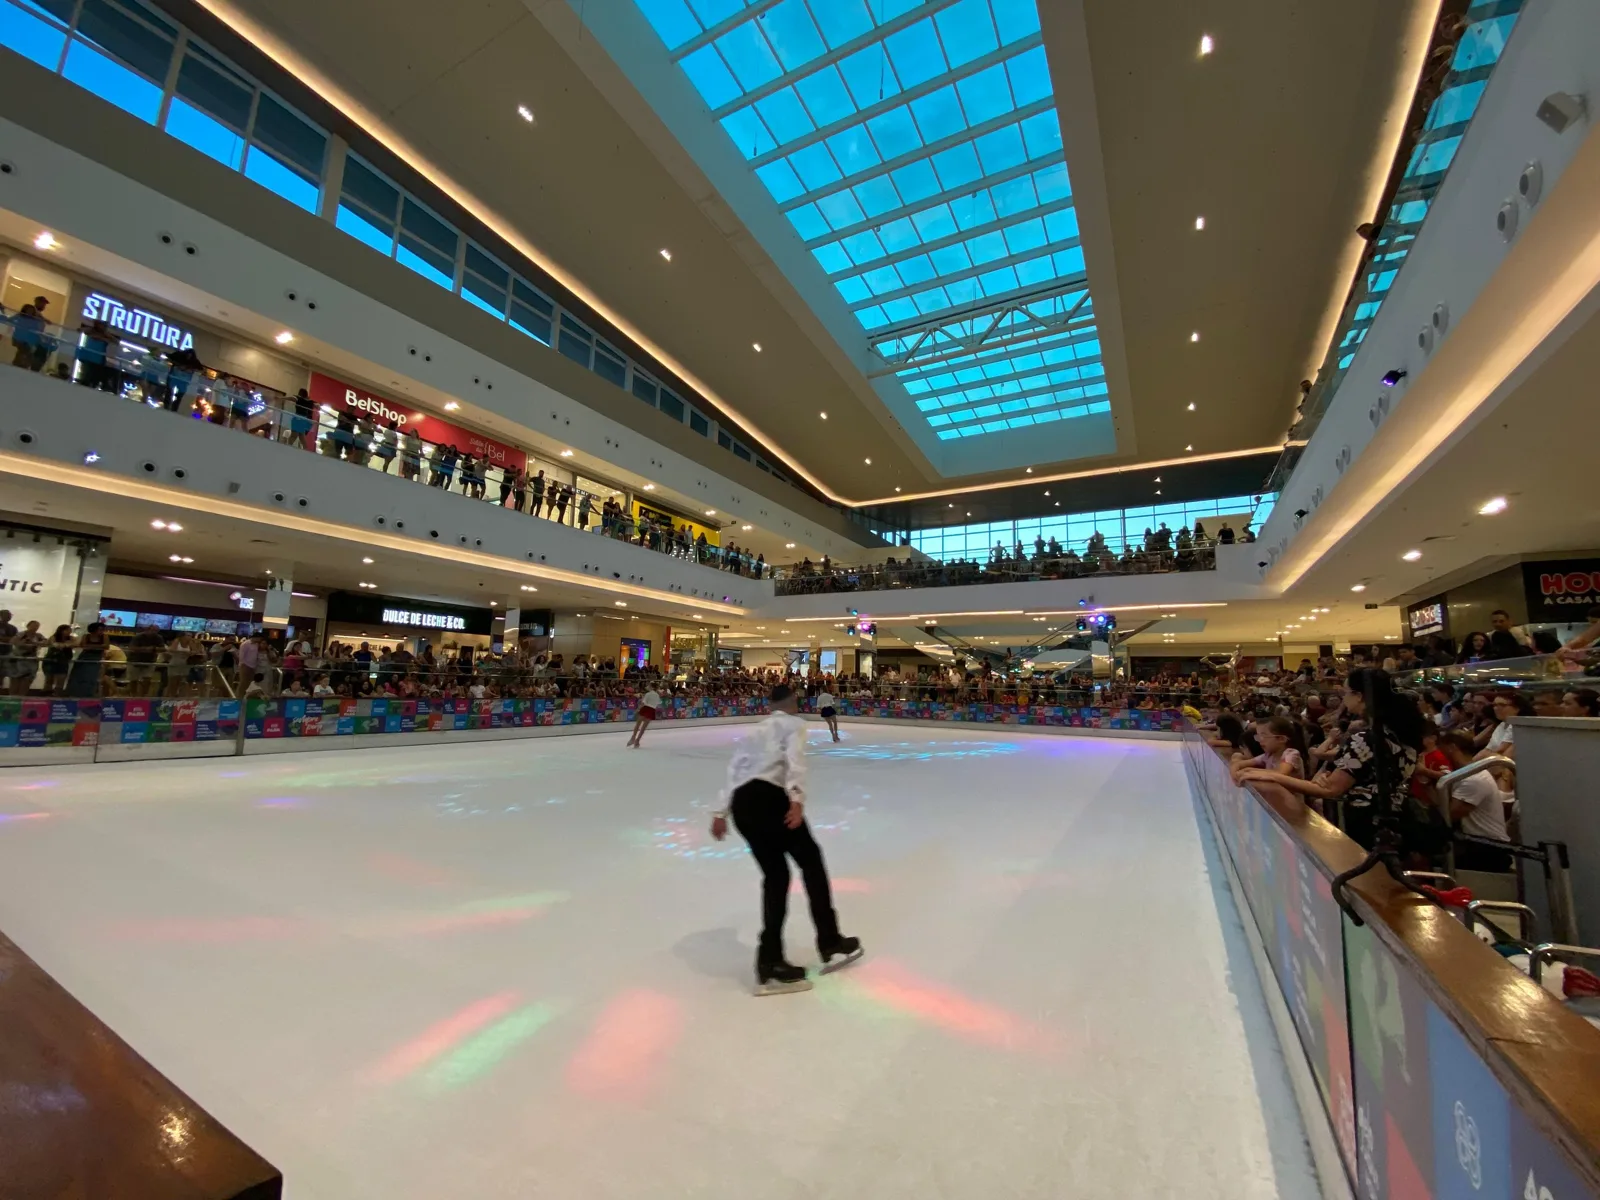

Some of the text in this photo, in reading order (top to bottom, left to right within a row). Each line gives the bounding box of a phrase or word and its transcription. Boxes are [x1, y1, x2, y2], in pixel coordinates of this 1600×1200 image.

[82, 293, 193, 347] STRUTURA
[345, 389, 407, 427] BelShop
[487, 444, 506, 461] Bel
[1543, 597, 1554, 605] A
[1556, 596, 1593, 605] CASA
[382, 609, 410, 624] DULCE
[410, 612, 422, 626] DE
[422, 613, 447, 628] LECHE
